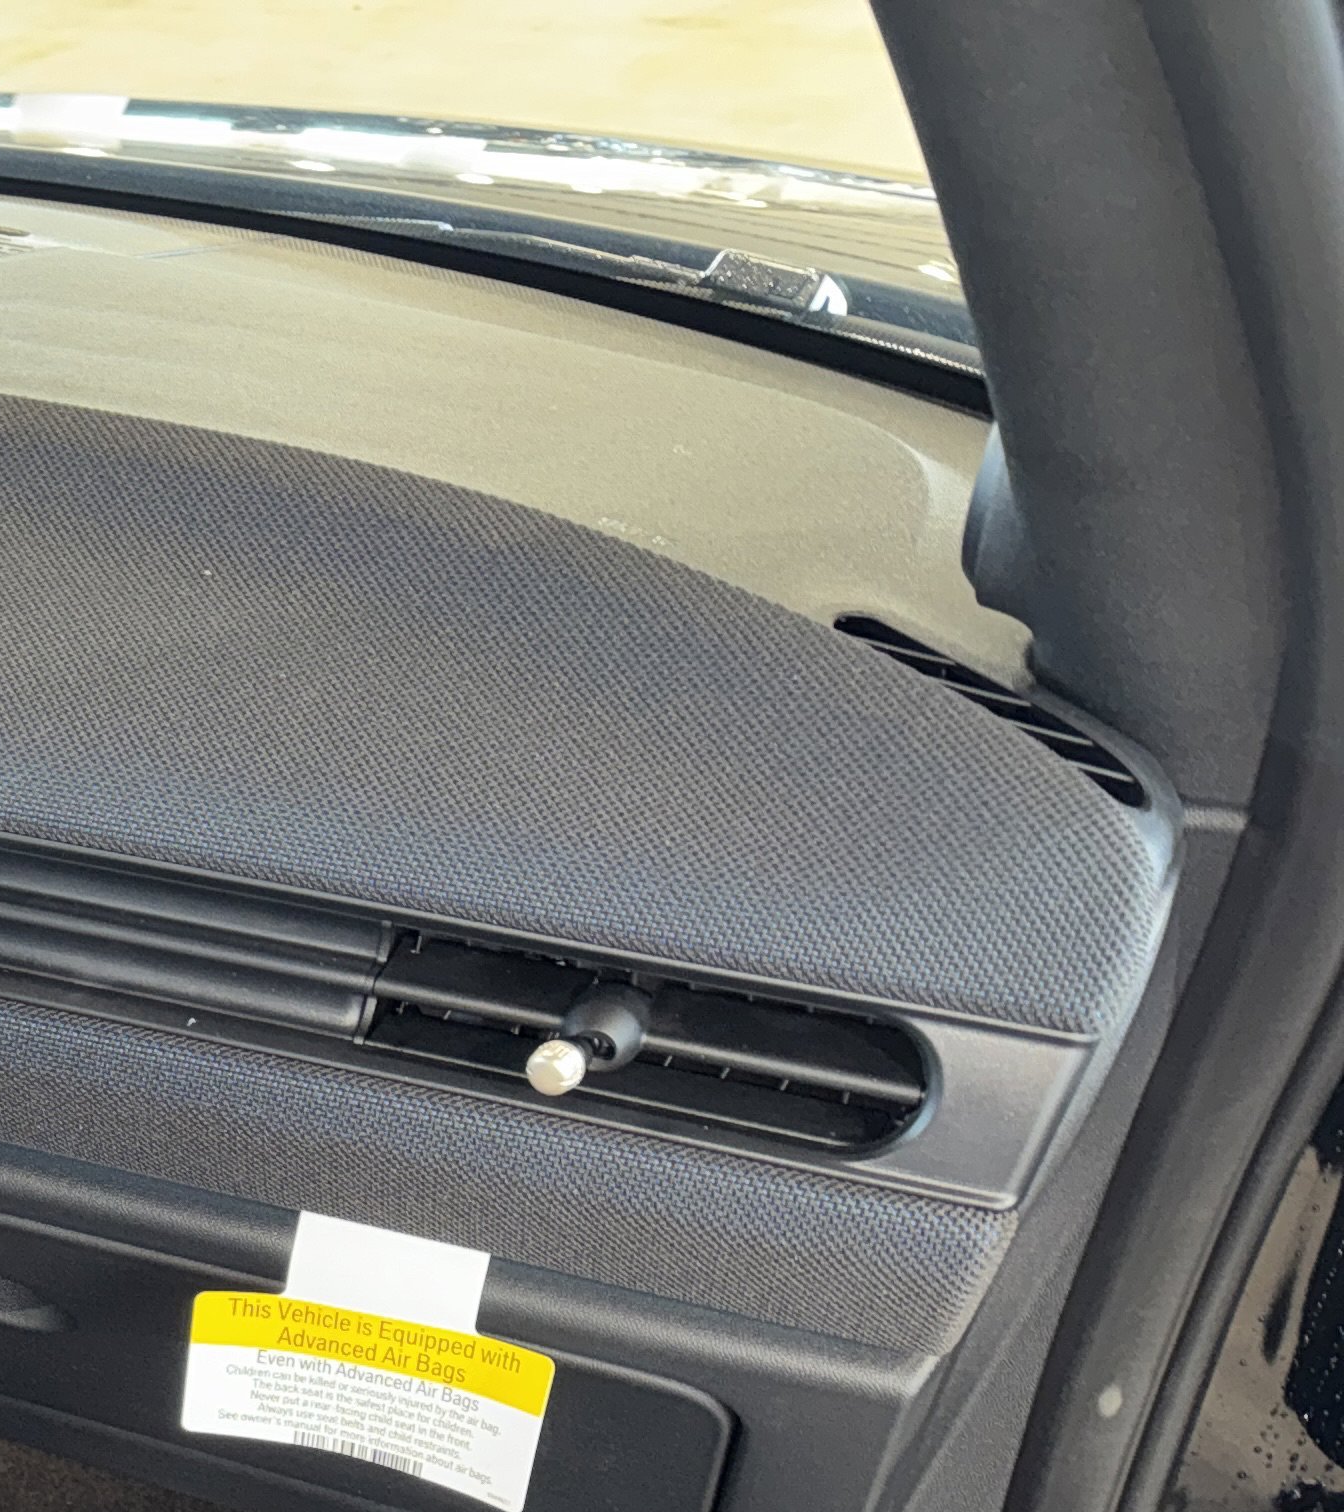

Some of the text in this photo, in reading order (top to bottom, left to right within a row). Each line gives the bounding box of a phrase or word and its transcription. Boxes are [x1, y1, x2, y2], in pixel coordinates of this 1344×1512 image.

[228, 1297, 522, 1374] This Vehicle is Equipped with
[276, 1326, 467, 1385] Advanced Air Bags
[226, 1363, 502, 1438] Children can be killed or seriously injured by the air bag.
[253, 1378, 475, 1439] The back seat is the safest place for children.
[256, 1348, 480, 1412] Even with Advanced Air Bags
[217, 1408, 240, 1421] See
[240, 1411, 283, 1427] owner's
[283, 1416, 323, 1433] manual
[323, 1424, 338, 1436] for
[338, 1427, 367, 1442] more
[367, 1431, 425, 1460] information
[425, 1451, 455, 1471] about
[455, 1461, 468, 1475] air
[249, 1389, 281, 1404] Never
[282, 1394, 301, 1409] put
[367, 1412, 394, 1427] child
[394, 1417, 417, 1431] seat
[417, 1422, 429, 1434] in
[429, 1426, 446, 1440] the
[446, 1430, 474, 1452] front.
[257, 1401, 463, 1461] Always use seat belts and child restraints.
